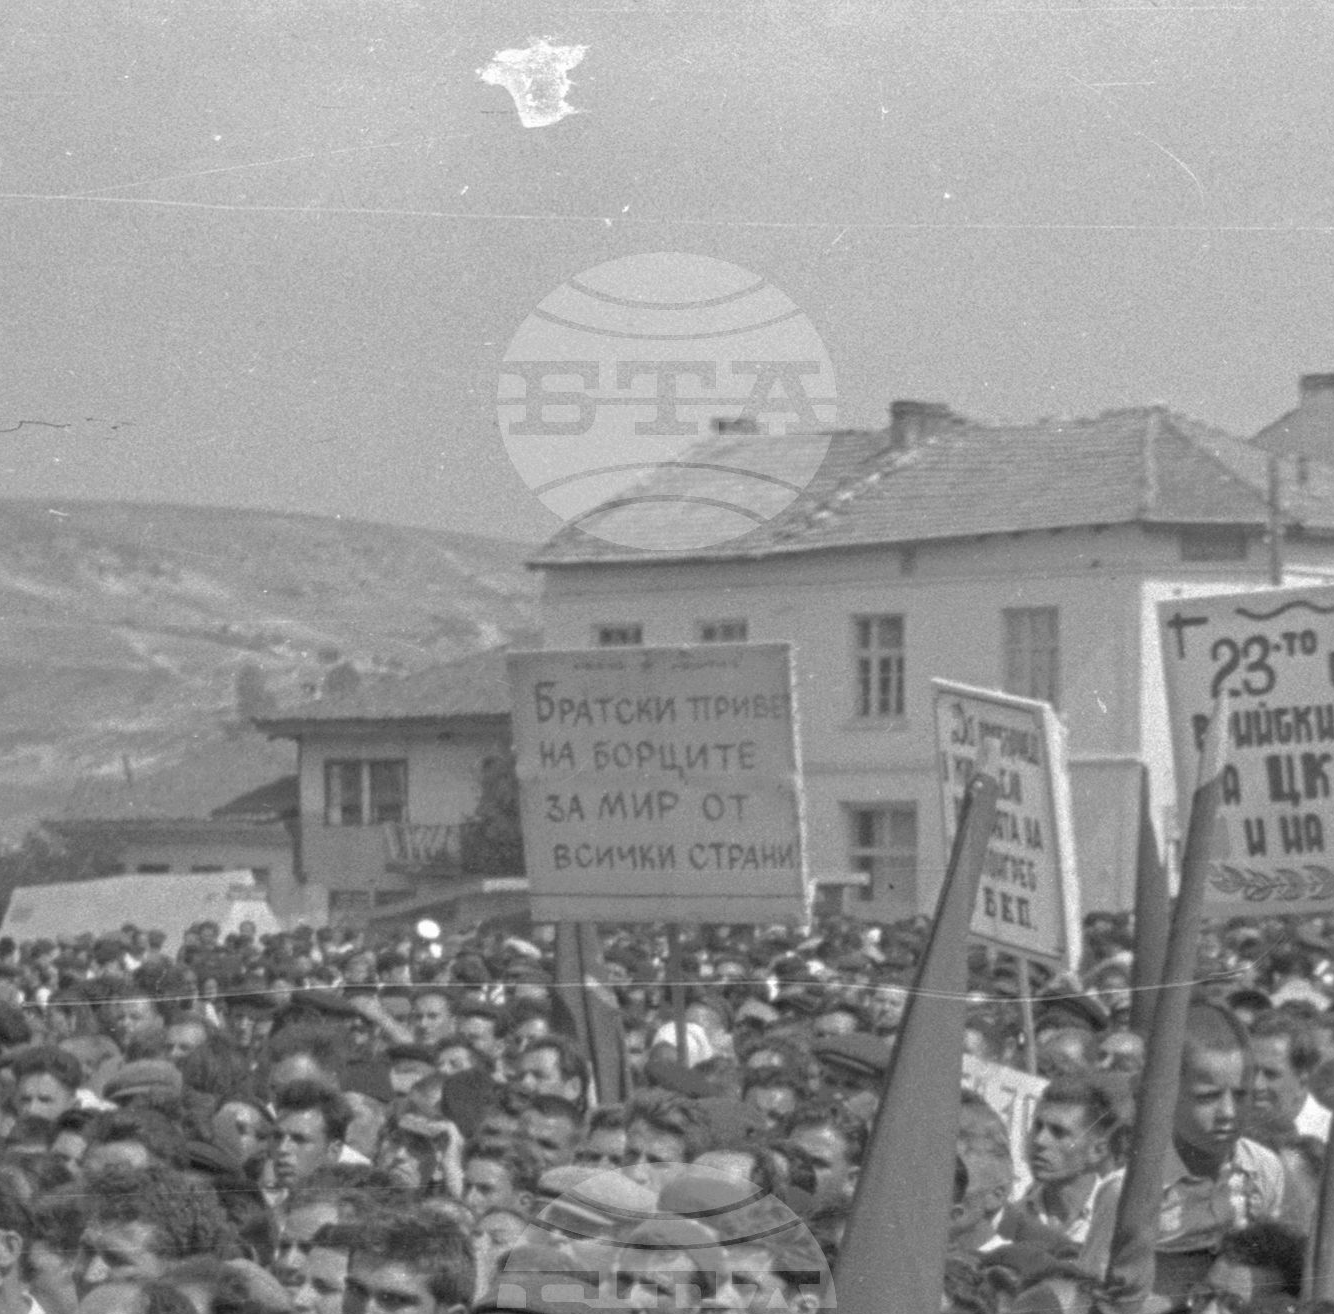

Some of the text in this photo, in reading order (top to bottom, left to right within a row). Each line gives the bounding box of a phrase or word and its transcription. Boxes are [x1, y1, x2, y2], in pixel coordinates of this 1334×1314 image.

[533, 680, 788, 727] БРАТСКИ ПРИВЕ
[538, 740, 757, 786] НА БОРЦИТЕ
[1265, 752, 1332, 808] ЦК
[544, 790, 750, 823] ЗА МИР ОТ
[1278, 813, 1324, 856] НА
[553, 842, 796, 872] ВСИЧКИ СТРАНИ
